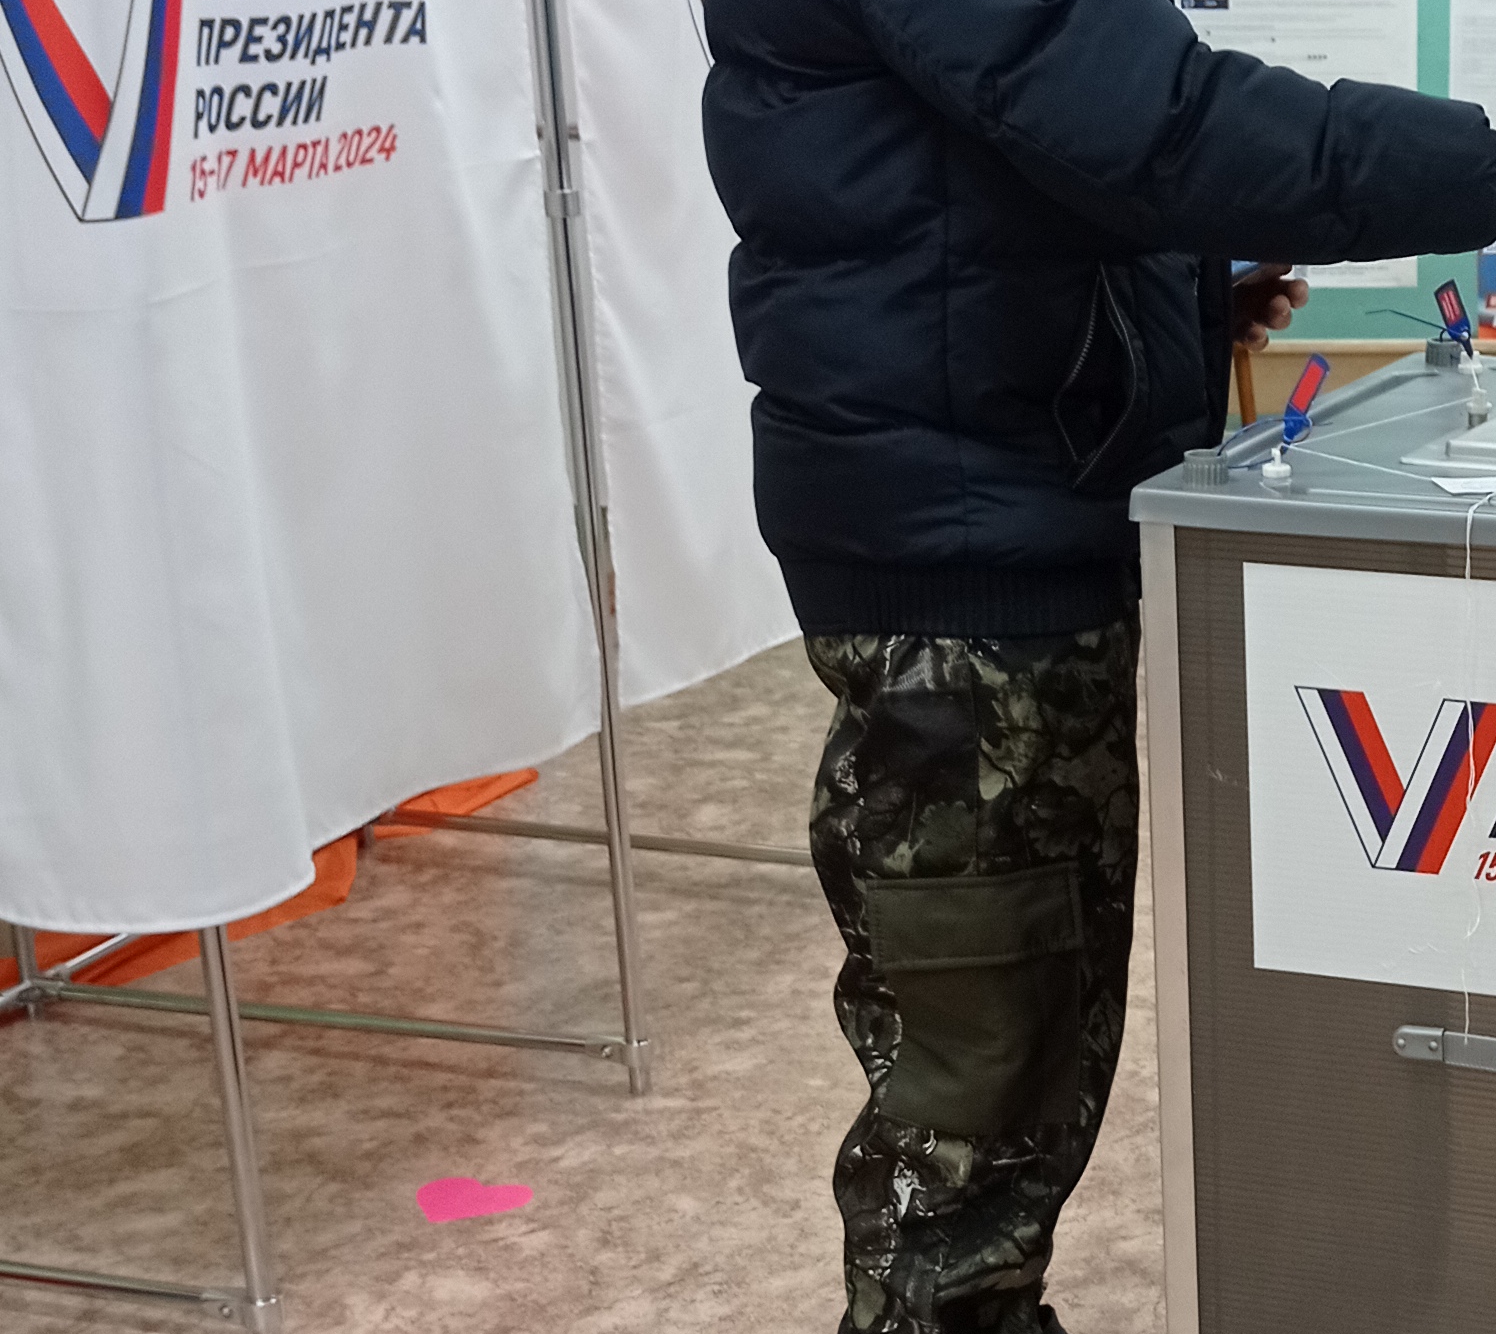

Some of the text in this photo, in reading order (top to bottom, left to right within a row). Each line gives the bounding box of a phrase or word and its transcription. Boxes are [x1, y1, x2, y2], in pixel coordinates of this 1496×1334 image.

[196, 0, 428, 67] ПРЕЗИДЕНТА
[193, 75, 328, 140] РОССИИ
[242, 137, 330, 188] МАРТА
[333, 124, 397, 174] 2024
